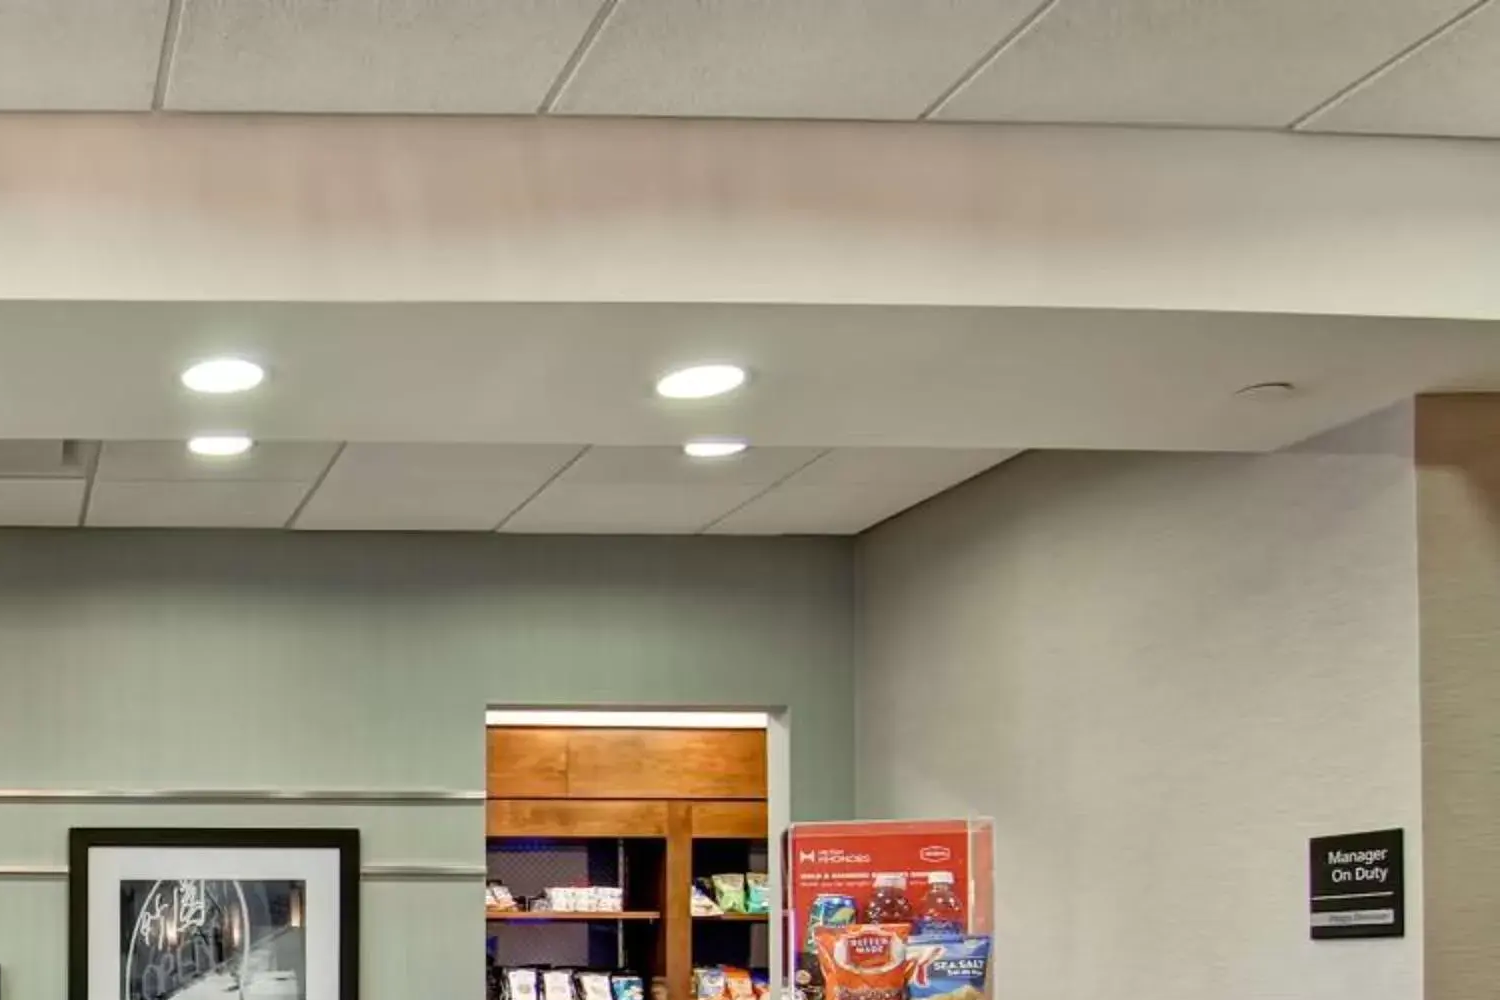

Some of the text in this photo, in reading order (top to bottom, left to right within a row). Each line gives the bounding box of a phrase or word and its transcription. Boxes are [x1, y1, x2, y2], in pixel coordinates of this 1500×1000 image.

[1328, 849, 1389, 865] Manager
[1332, 867, 1389, 883] On Duty
[959, 959, 985, 969] SALT
